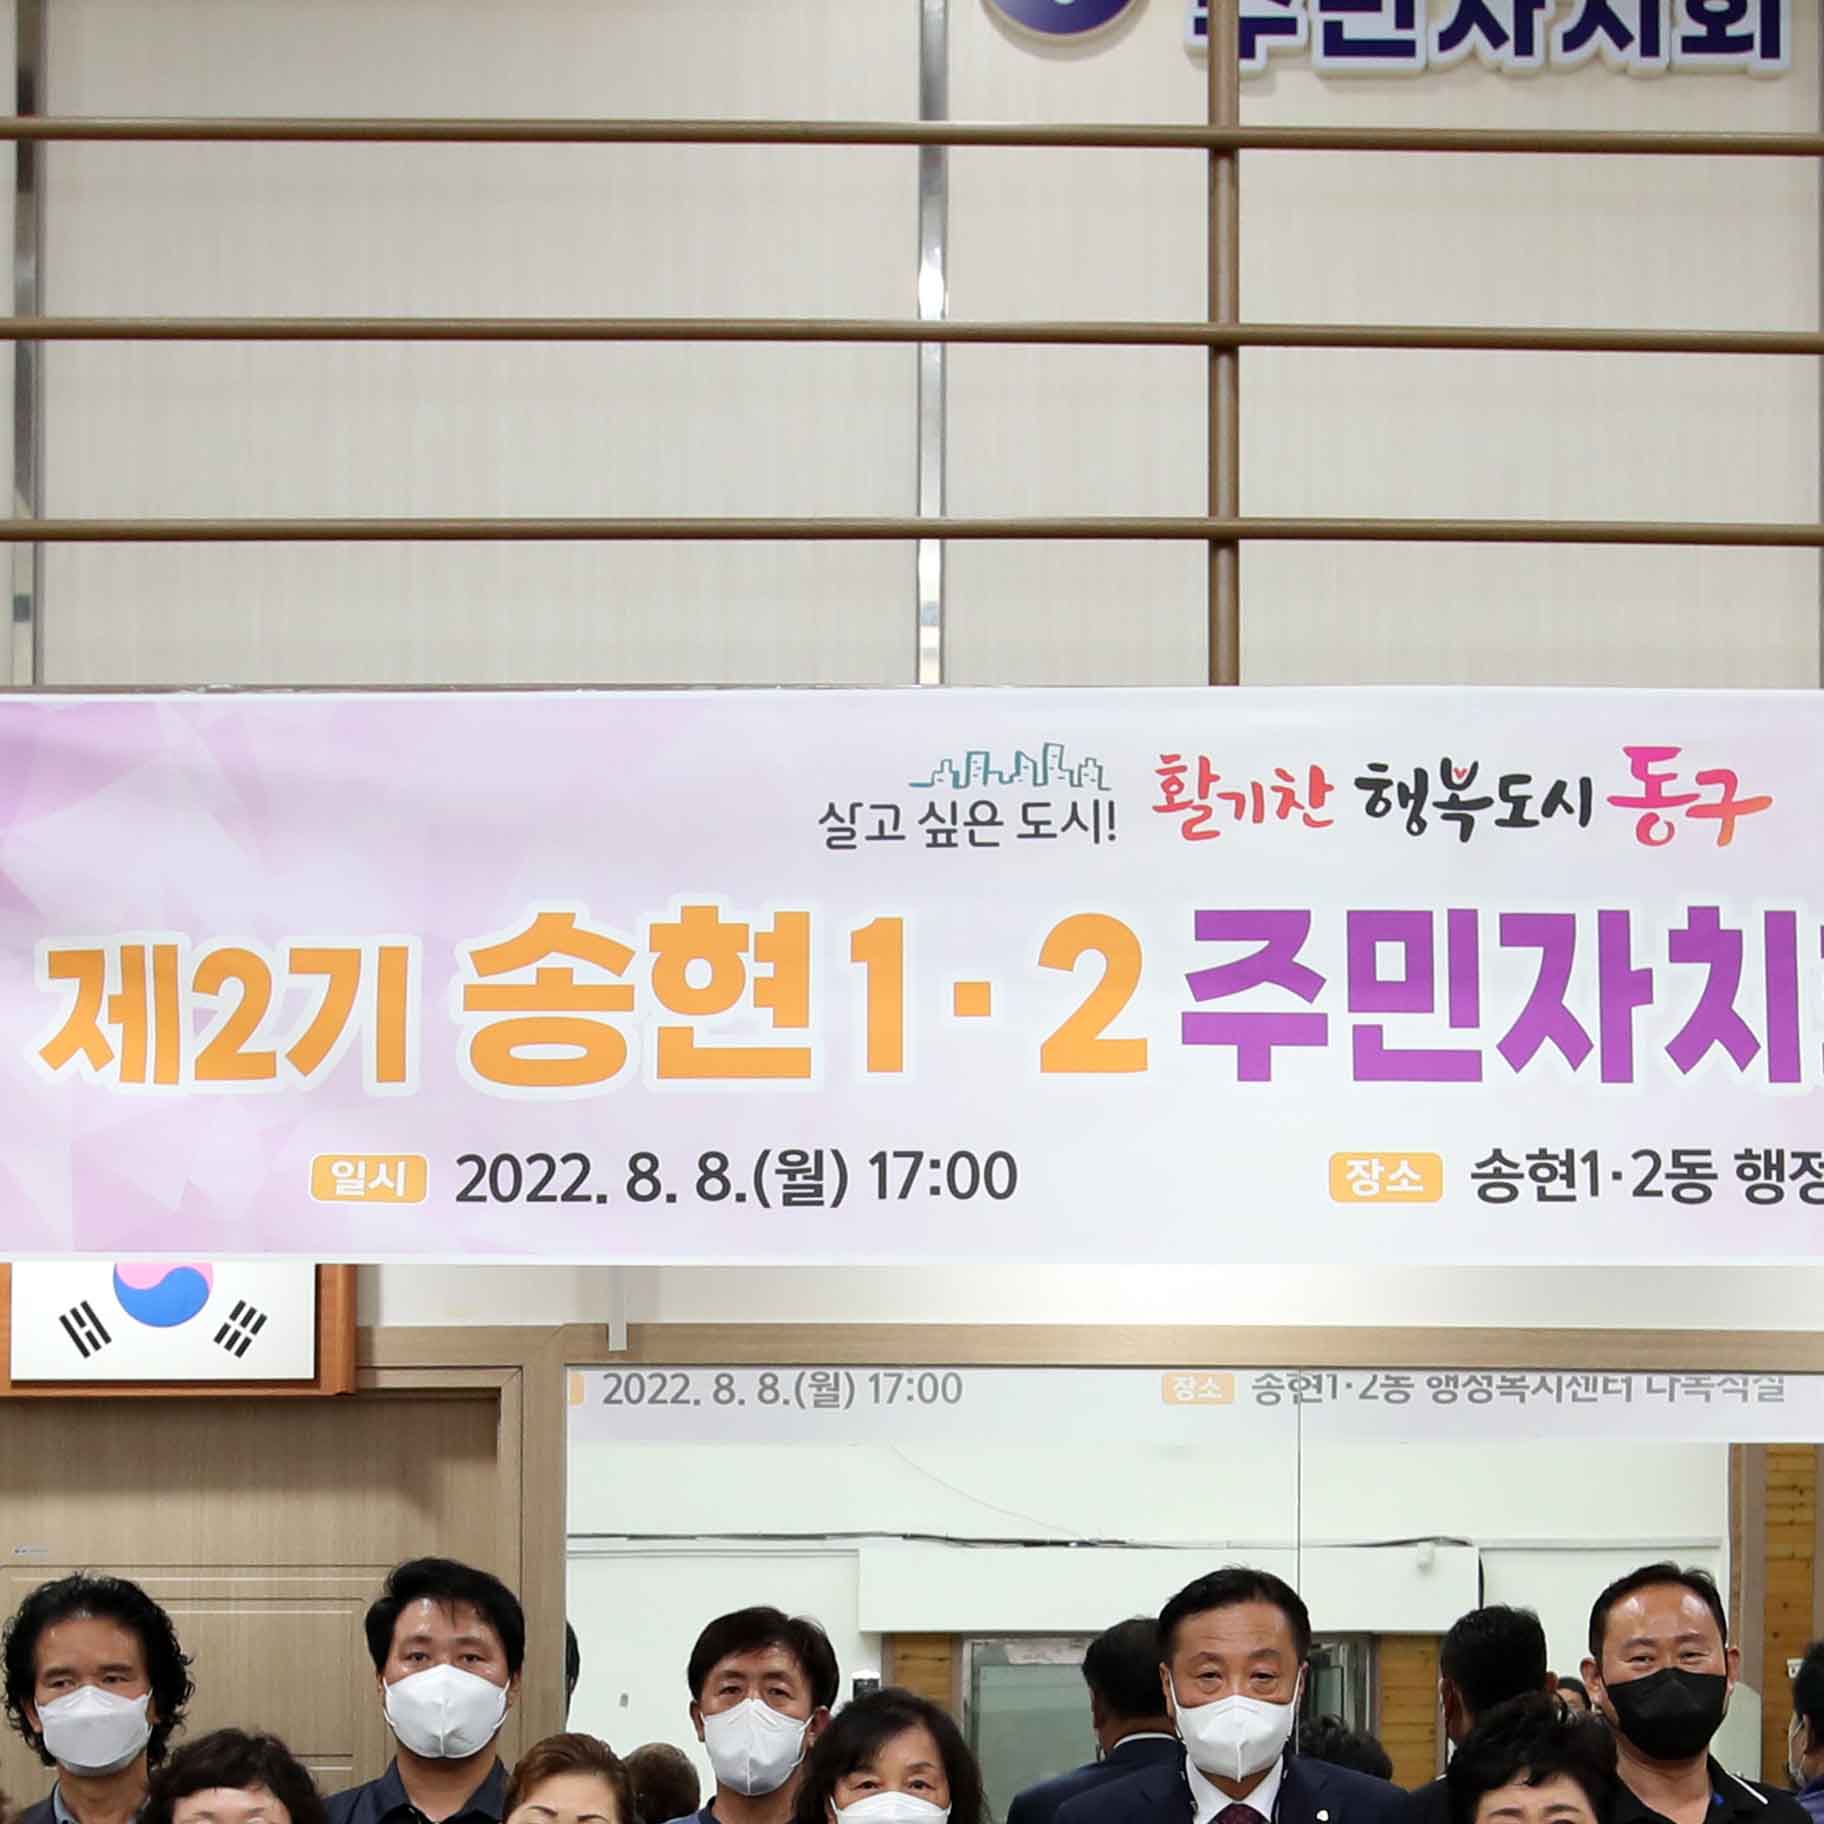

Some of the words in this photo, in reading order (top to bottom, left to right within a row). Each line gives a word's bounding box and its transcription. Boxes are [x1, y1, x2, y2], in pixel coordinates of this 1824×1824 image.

[1153, 753, 1334, 841] 활기찬
[1354, 756, 1593, 843] 행복도시
[1607, 746, 1772, 847] 동구
[818, 801, 906, 850] 살고
[918, 800, 1004, 848] 싶은
[1017, 798, 1116, 844] 도시!
[41, 944, 407, 1084] 제2기
[331, 1160, 407, 1197] 일시
[455, 1152, 608, 1204] 2022.
[626, 1151, 677, 1203] 8.
[869, 1150, 1017, 1200] 17:00
[1344, 1158, 1426, 1196] 장소
[867, 1371, 964, 1405] 17:00
